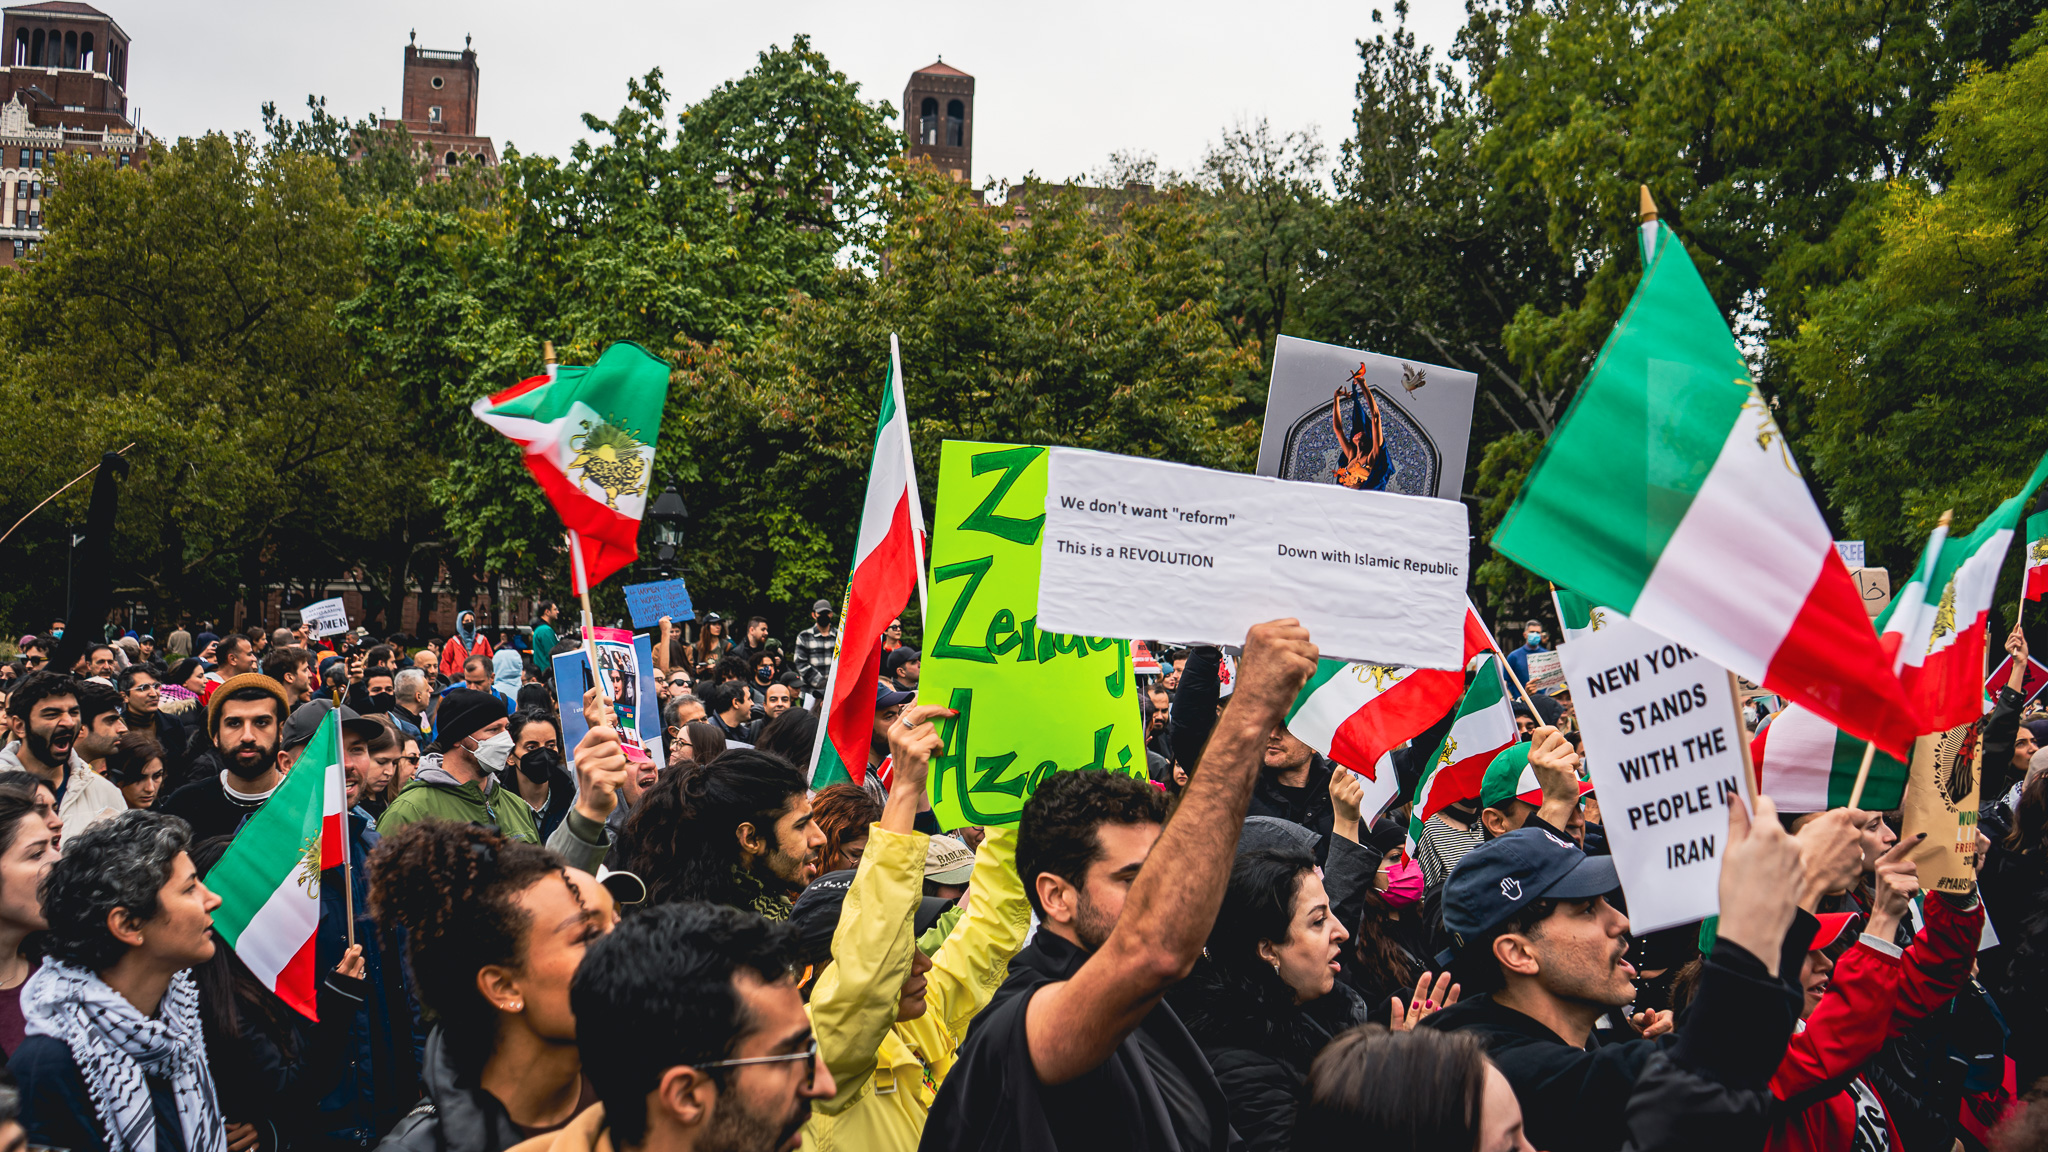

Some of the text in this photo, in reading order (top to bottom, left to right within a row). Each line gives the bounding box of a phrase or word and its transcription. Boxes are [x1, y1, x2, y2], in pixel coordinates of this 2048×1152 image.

[1060, 495, 1235, 526] We don't want "reform"
[1057, 540, 1214, 568] This is a REVOLUTION
[1278, 543, 1459, 577] Down with Islamic Republic
[1834, 544, 1864, 561] REE
[320, 617, 347, 631] OMEN
[1586, 658, 1641, 698] NEW
[1644, 642, 1699, 675] YOR
[1619, 683, 1707, 735] STANDS
[1618, 727, 1727, 783] WITH THE
[1627, 775, 1739, 831] PEOPLE IN
[1667, 834, 1715, 869] IRAN
[1955, 842, 1975, 853] FREE
